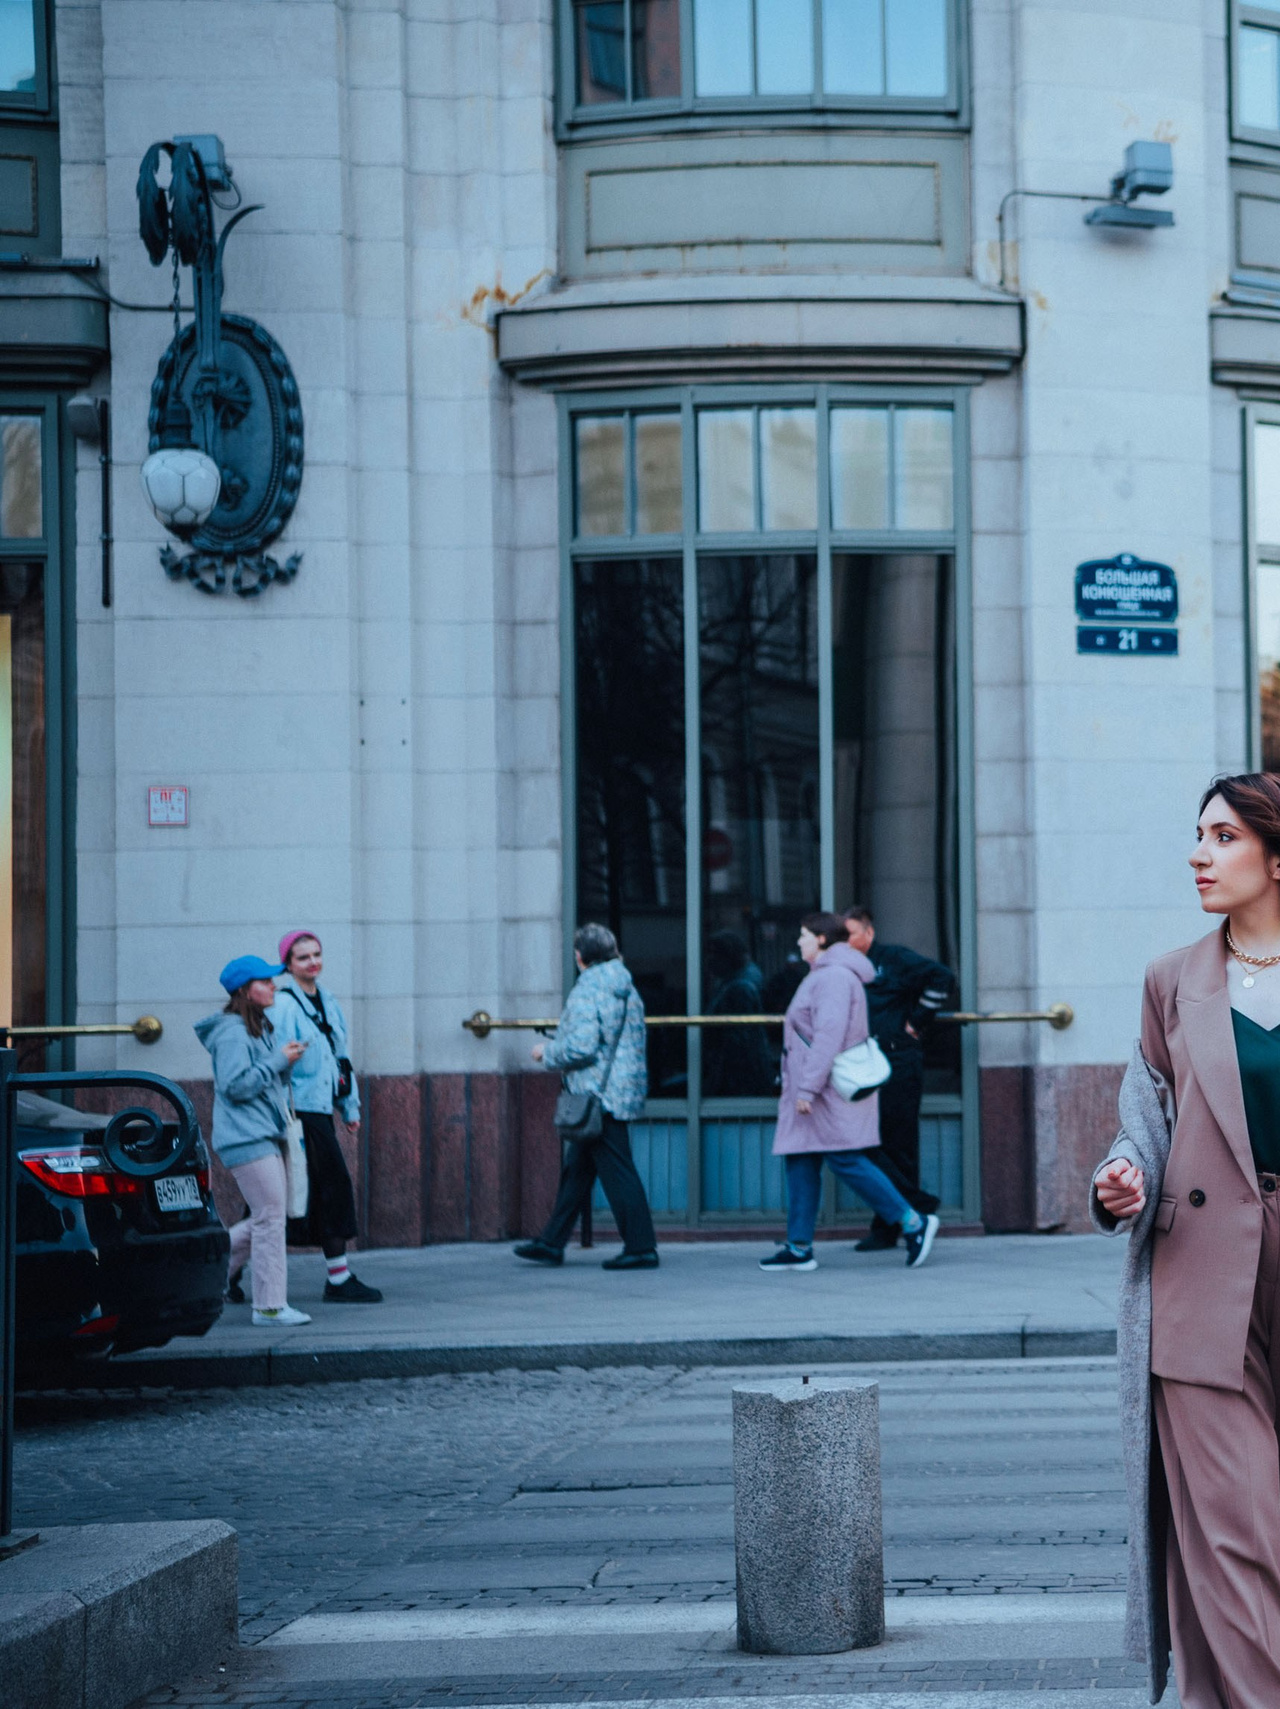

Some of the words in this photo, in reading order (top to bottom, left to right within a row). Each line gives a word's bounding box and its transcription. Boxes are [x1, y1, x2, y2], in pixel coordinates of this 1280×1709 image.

[1095, 568, 1159, 586] БОЛЬШАЯ
[1082, 584, 1172, 602] КОНЮШЕННАЯ
[1118, 629, 1138, 650] 21
